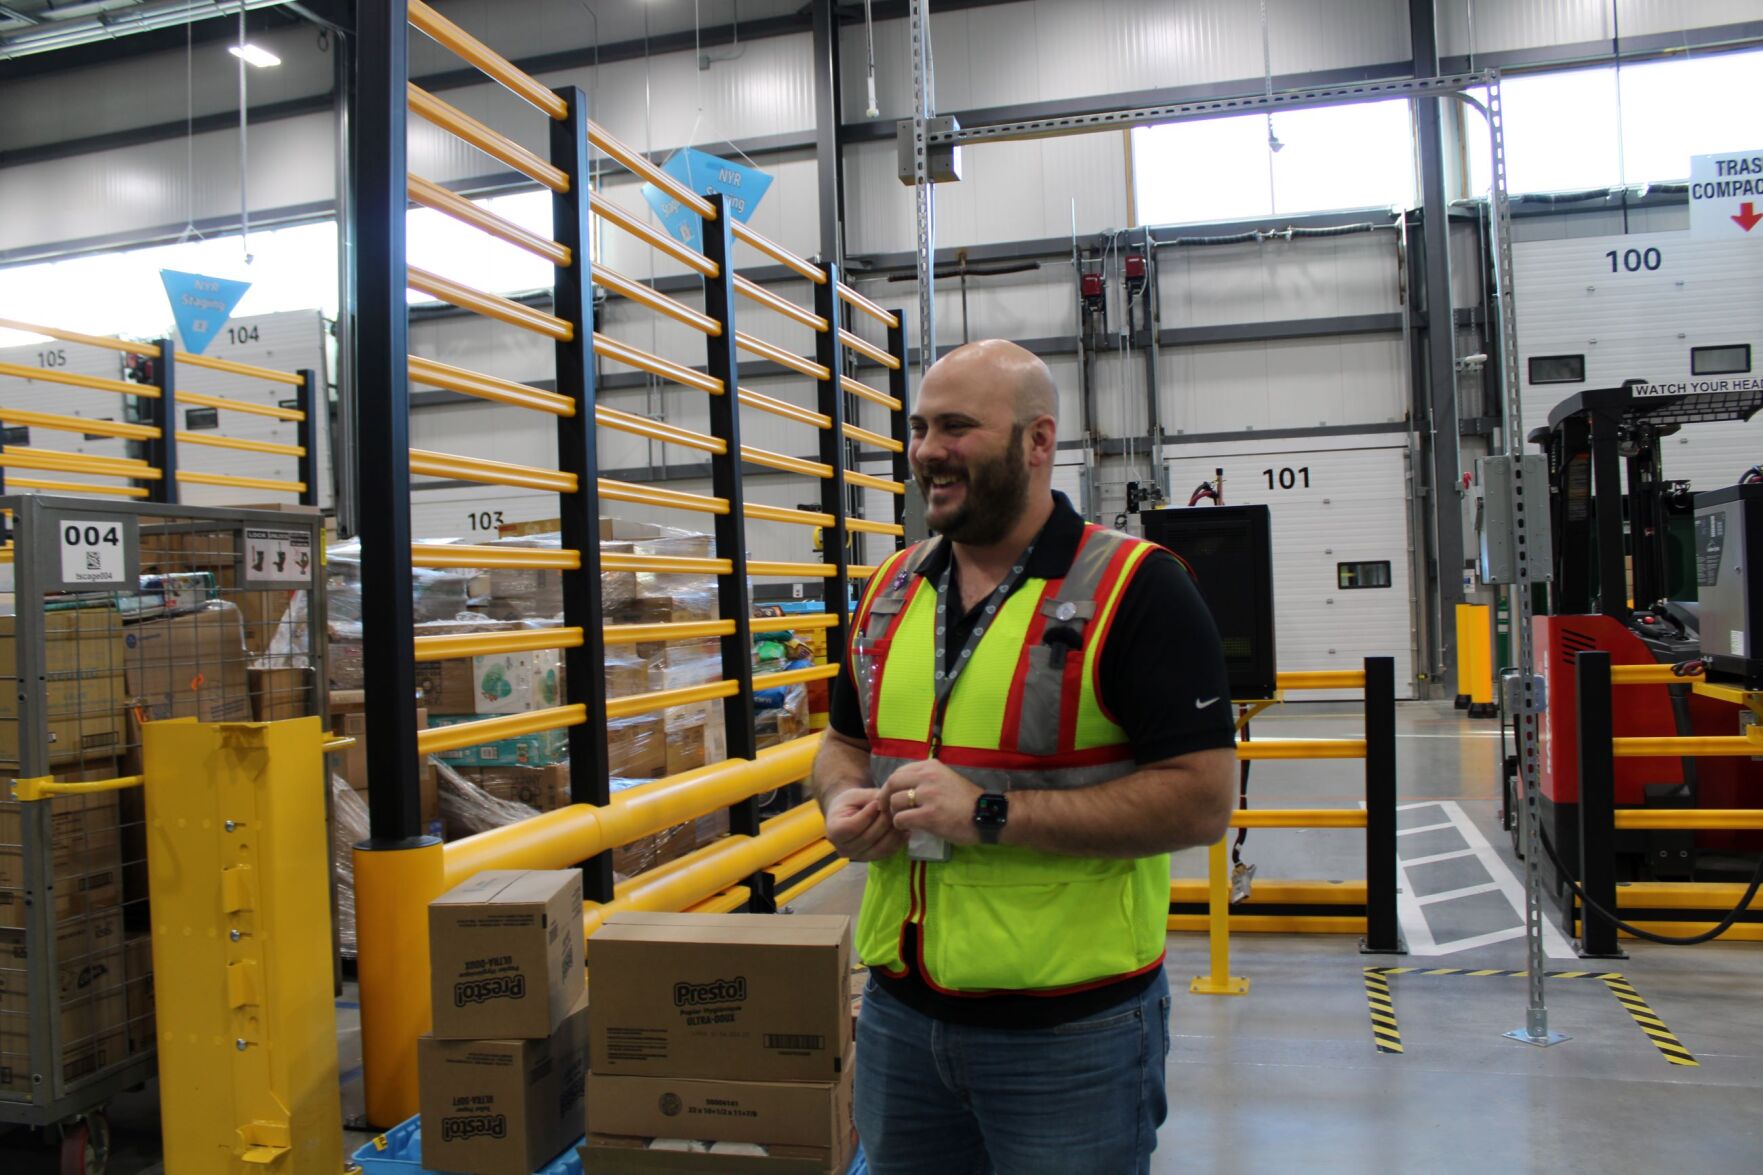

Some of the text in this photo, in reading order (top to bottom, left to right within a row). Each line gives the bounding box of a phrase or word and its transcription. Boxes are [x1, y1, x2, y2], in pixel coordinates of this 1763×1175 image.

[718, 168, 742, 186] NYR
[1605, 247, 1662, 272] 100
[227, 324, 260, 345] 104
[38, 349, 67, 368] 105
[1636, 383, 1687, 396] WATCH
[1690, 381, 1729, 393] YOUR
[1263, 466, 1310, 490] 101
[468, 511, 504, 531] 103
[65, 526, 119, 546] 004
[455, 975, 525, 1006] Presto!
[674, 977, 746, 1006] Presto!
[442, 1114, 506, 1141] Presto!
